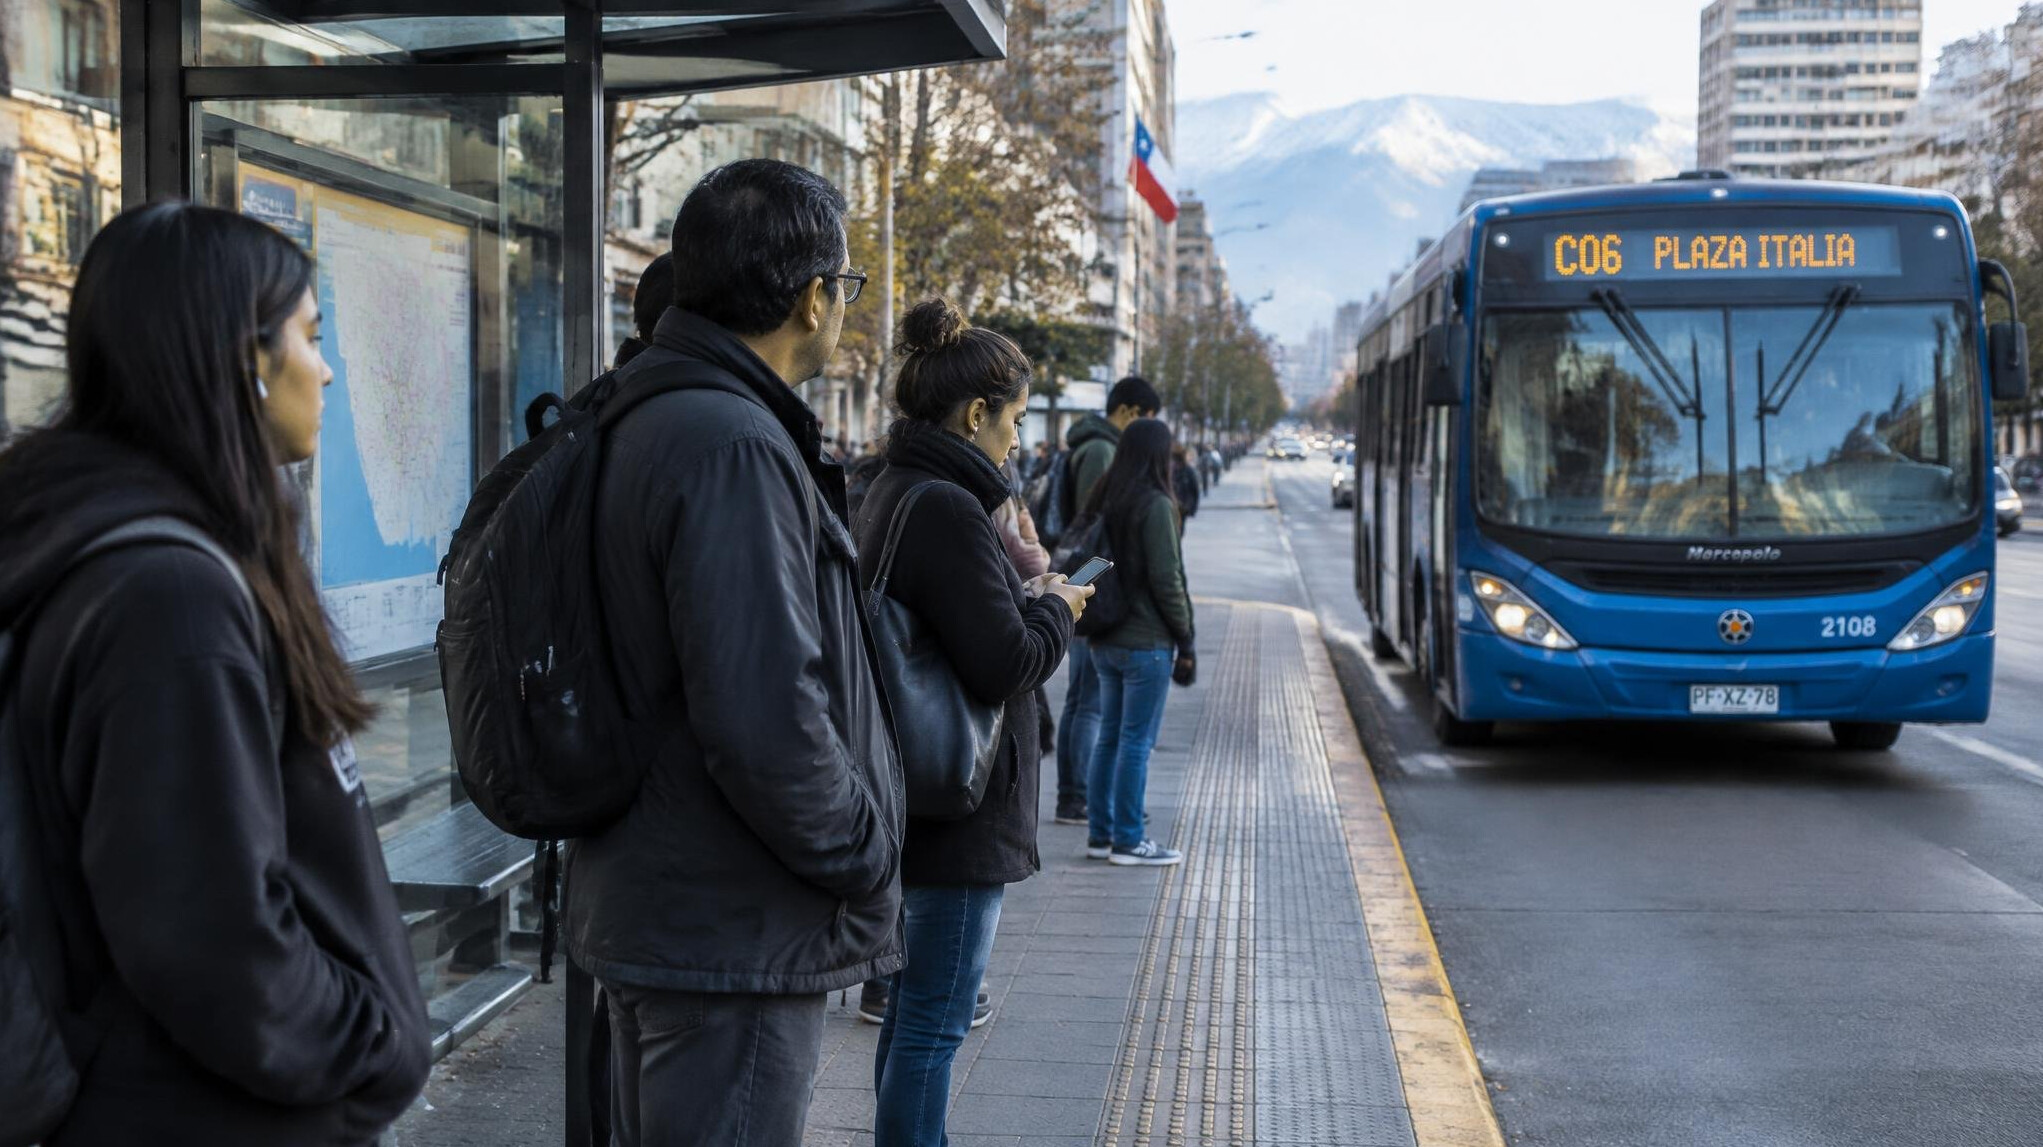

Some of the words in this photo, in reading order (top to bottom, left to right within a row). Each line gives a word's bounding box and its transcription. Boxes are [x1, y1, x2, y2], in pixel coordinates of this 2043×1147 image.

[1655, 235, 1746, 269] PLAZA
[1758, 233, 1855, 268] ITALIA
[1821, 616, 1876, 638] 2108
